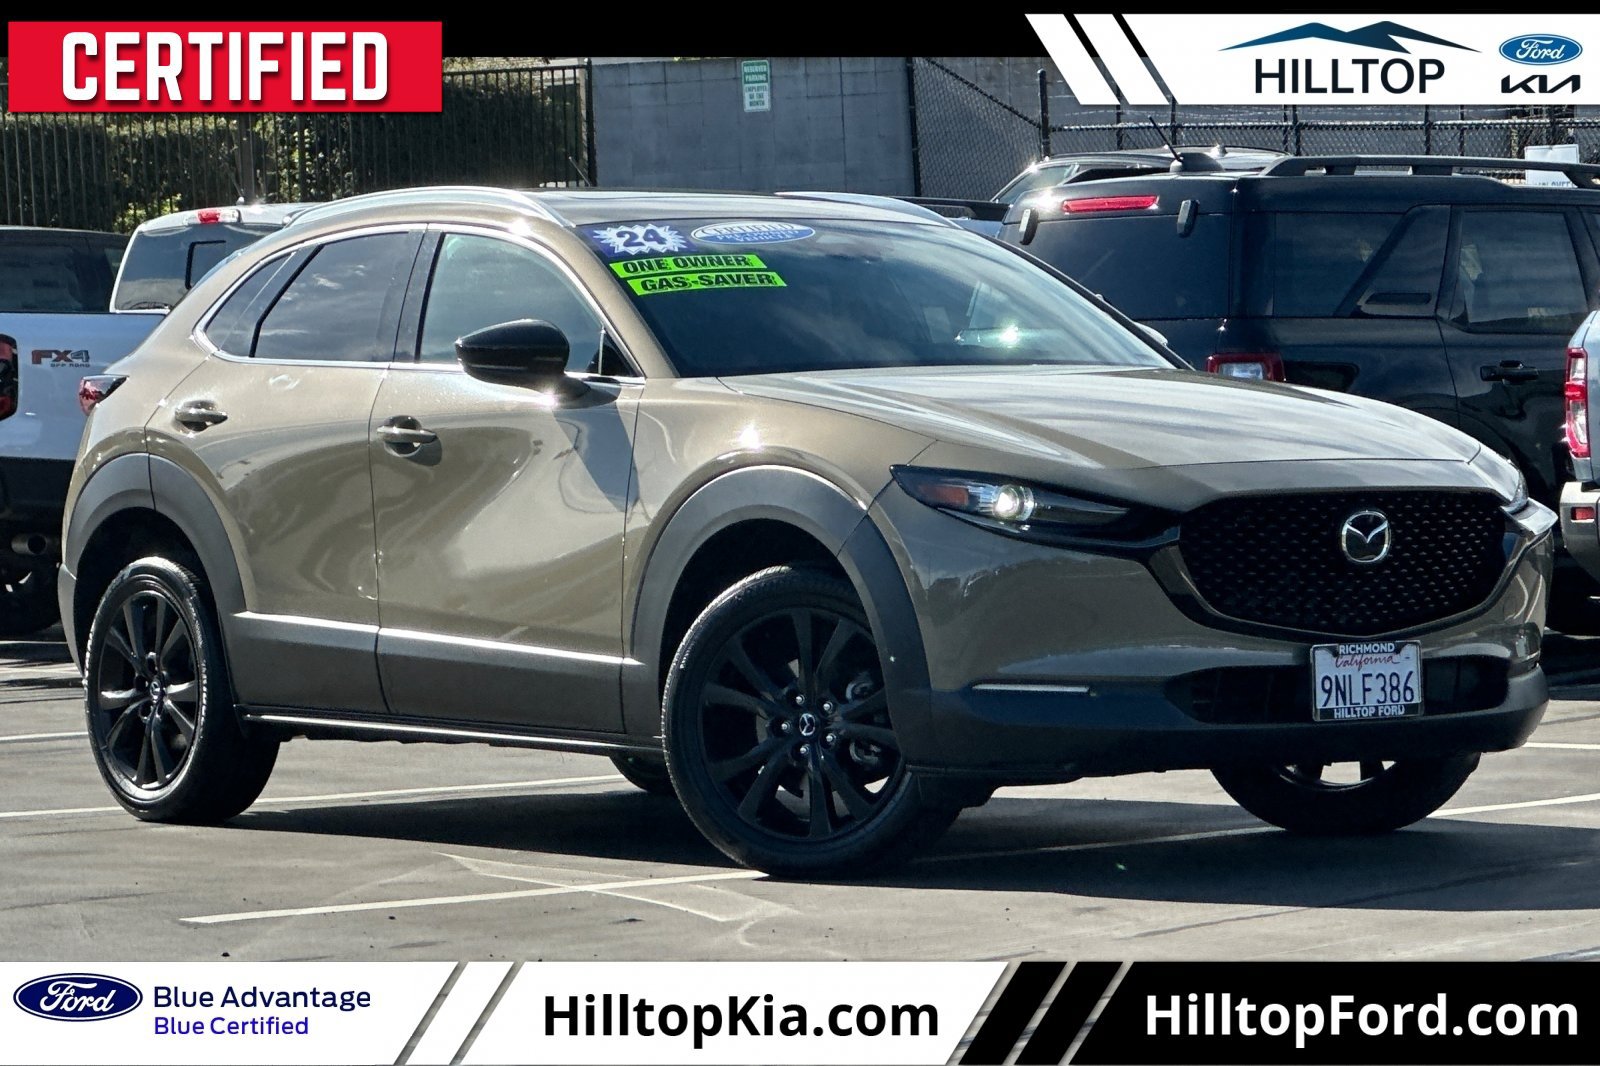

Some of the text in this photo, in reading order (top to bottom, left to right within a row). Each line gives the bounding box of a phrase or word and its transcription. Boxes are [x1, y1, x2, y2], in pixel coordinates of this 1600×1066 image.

[616, 229, 667, 247] 24
[623, 255, 751, 274] ONE OWNER
[640, 274, 776, 292] GAS-SAVER
[31, 349, 90, 364] FX4
[1339, 643, 1395, 655] RICHMOND
[1335, 654, 1400, 671] California
[1321, 670, 1414, 707] 9NLF386
[1334, 704, 1405, 719] HILLTOP FORD
